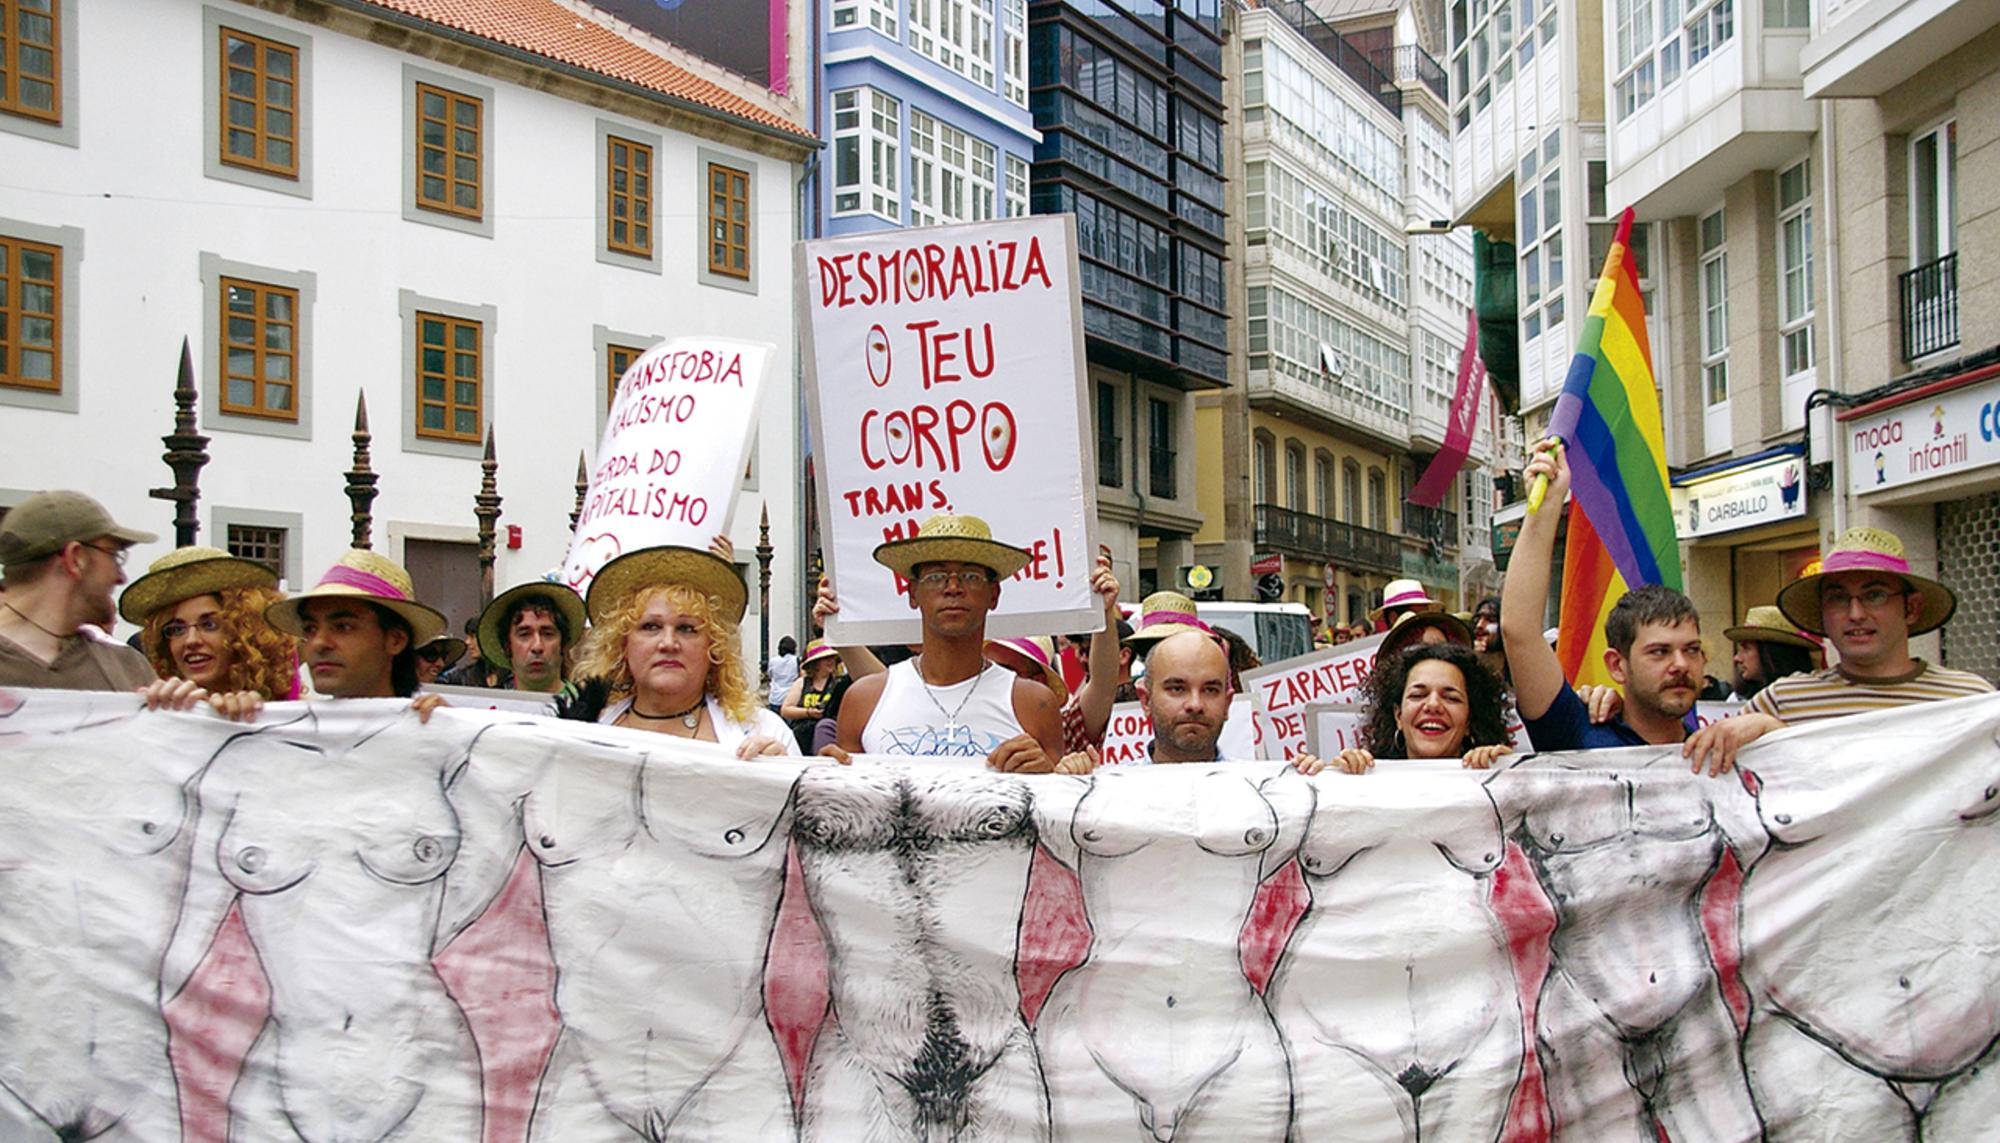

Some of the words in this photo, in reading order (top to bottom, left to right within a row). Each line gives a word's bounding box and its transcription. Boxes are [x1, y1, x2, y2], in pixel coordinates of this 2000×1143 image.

[866, 323, 891, 387] O
[906, 320, 995, 390] TEU
[860, 399, 1017, 472] CORPO
[1854, 419, 1903, 453] moda
[1908, 432, 1968, 474] infantil
[646, 448, 681, 475] DO
[1707, 495, 1768, 522] CARBALLO
